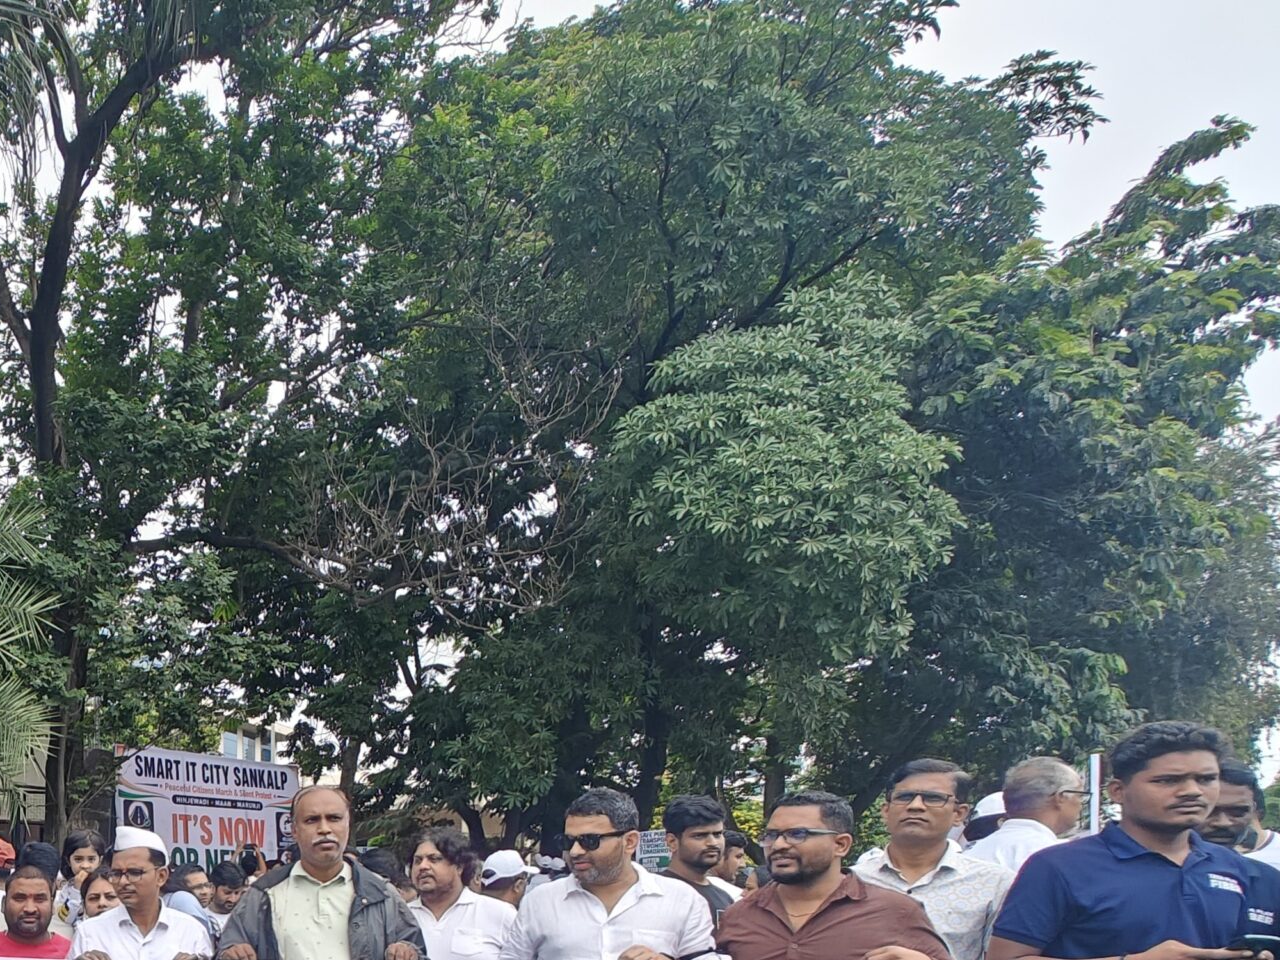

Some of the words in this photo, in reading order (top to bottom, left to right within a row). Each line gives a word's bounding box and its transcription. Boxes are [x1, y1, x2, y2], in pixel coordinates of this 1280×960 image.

[135, 755, 180, 781] SMART
[186, 762, 197, 782] IT
[202, 763, 229, 785] CITY
[233, 766, 288, 790] SANKALP
[172, 813, 213, 846] IT'S
[219, 816, 265, 848] NOW
